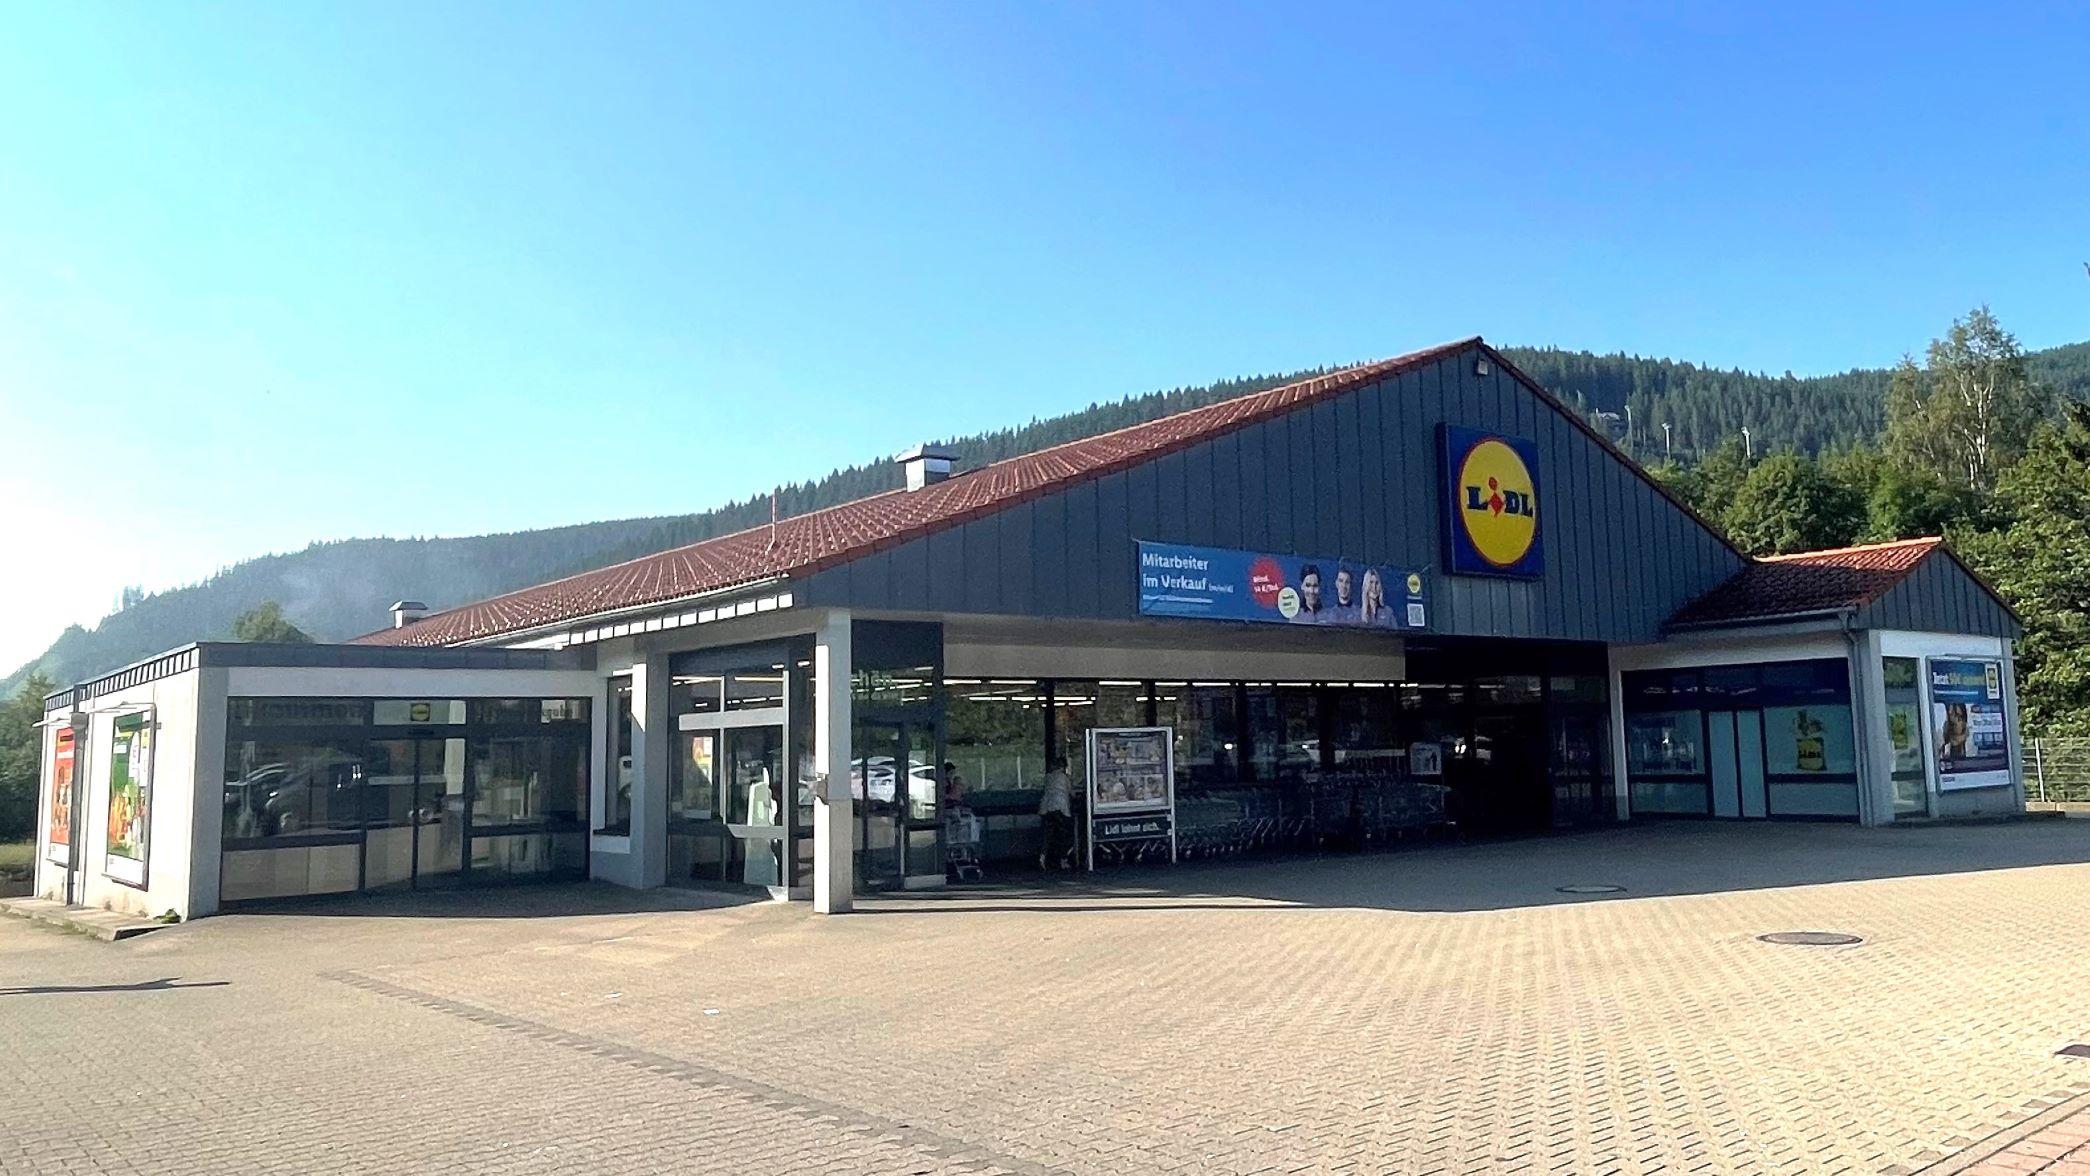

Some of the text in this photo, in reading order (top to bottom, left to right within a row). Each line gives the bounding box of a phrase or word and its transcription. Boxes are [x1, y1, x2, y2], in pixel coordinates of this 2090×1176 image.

[1466, 476, 1534, 518] LIDL
[1142, 553, 1209, 571] Mitarbeiter
[1142, 573, 1158, 588] im
[1161, 575, 1207, 590] Verkauf
